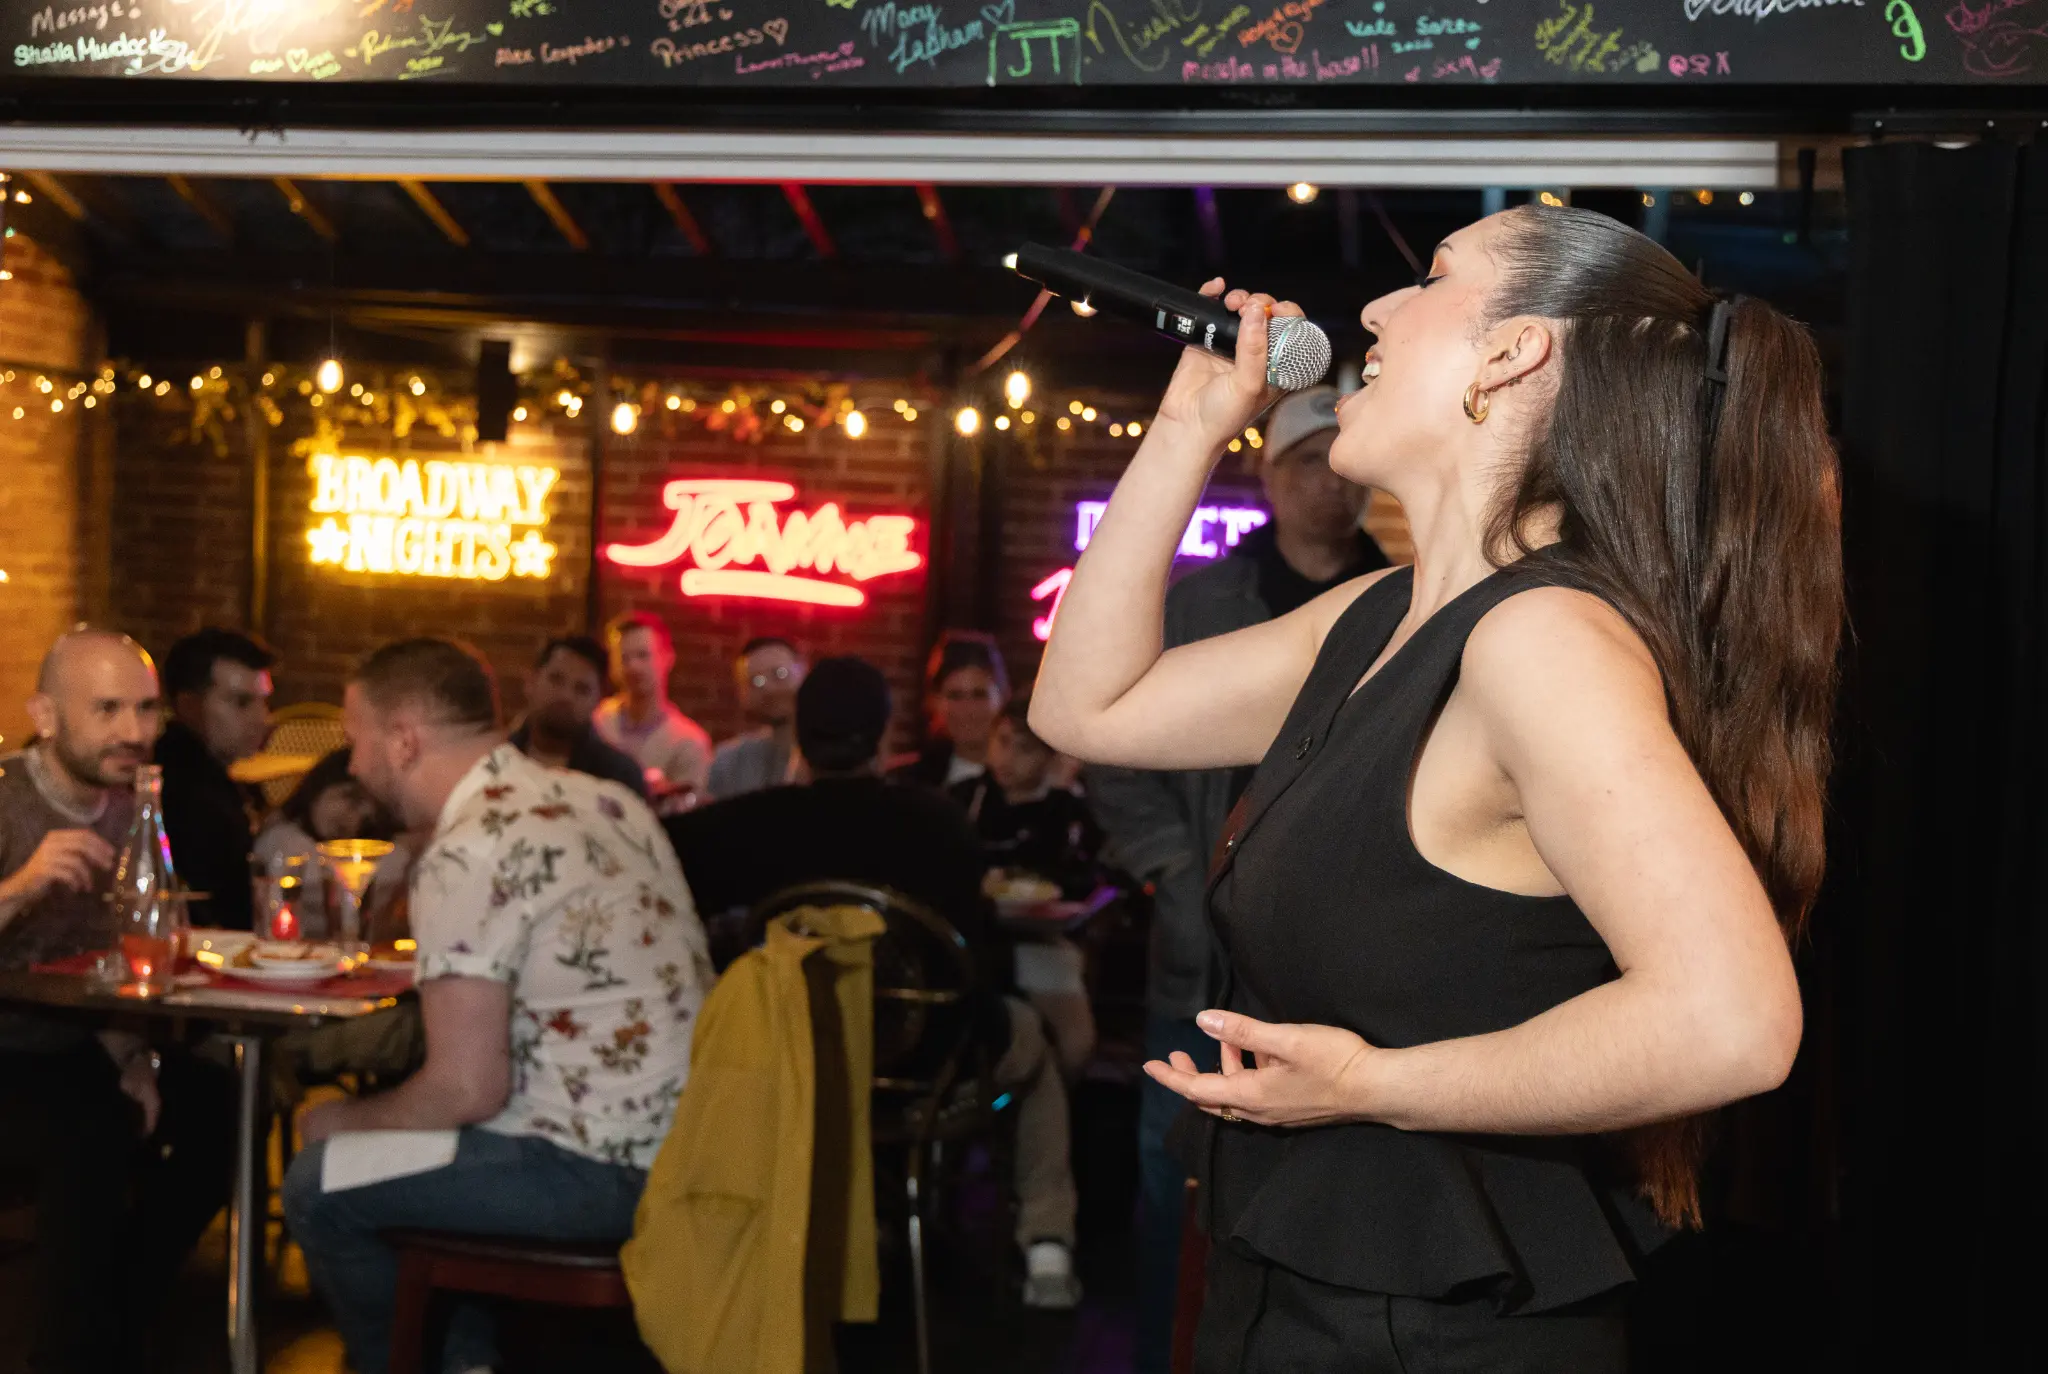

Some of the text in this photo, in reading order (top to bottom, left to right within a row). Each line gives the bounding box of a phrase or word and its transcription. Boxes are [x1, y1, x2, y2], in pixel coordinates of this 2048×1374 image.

[650, 28, 765, 69] Princess
[308, 454, 560, 526] BROADWAY
[343, 513, 512, 582] NIGHTS
